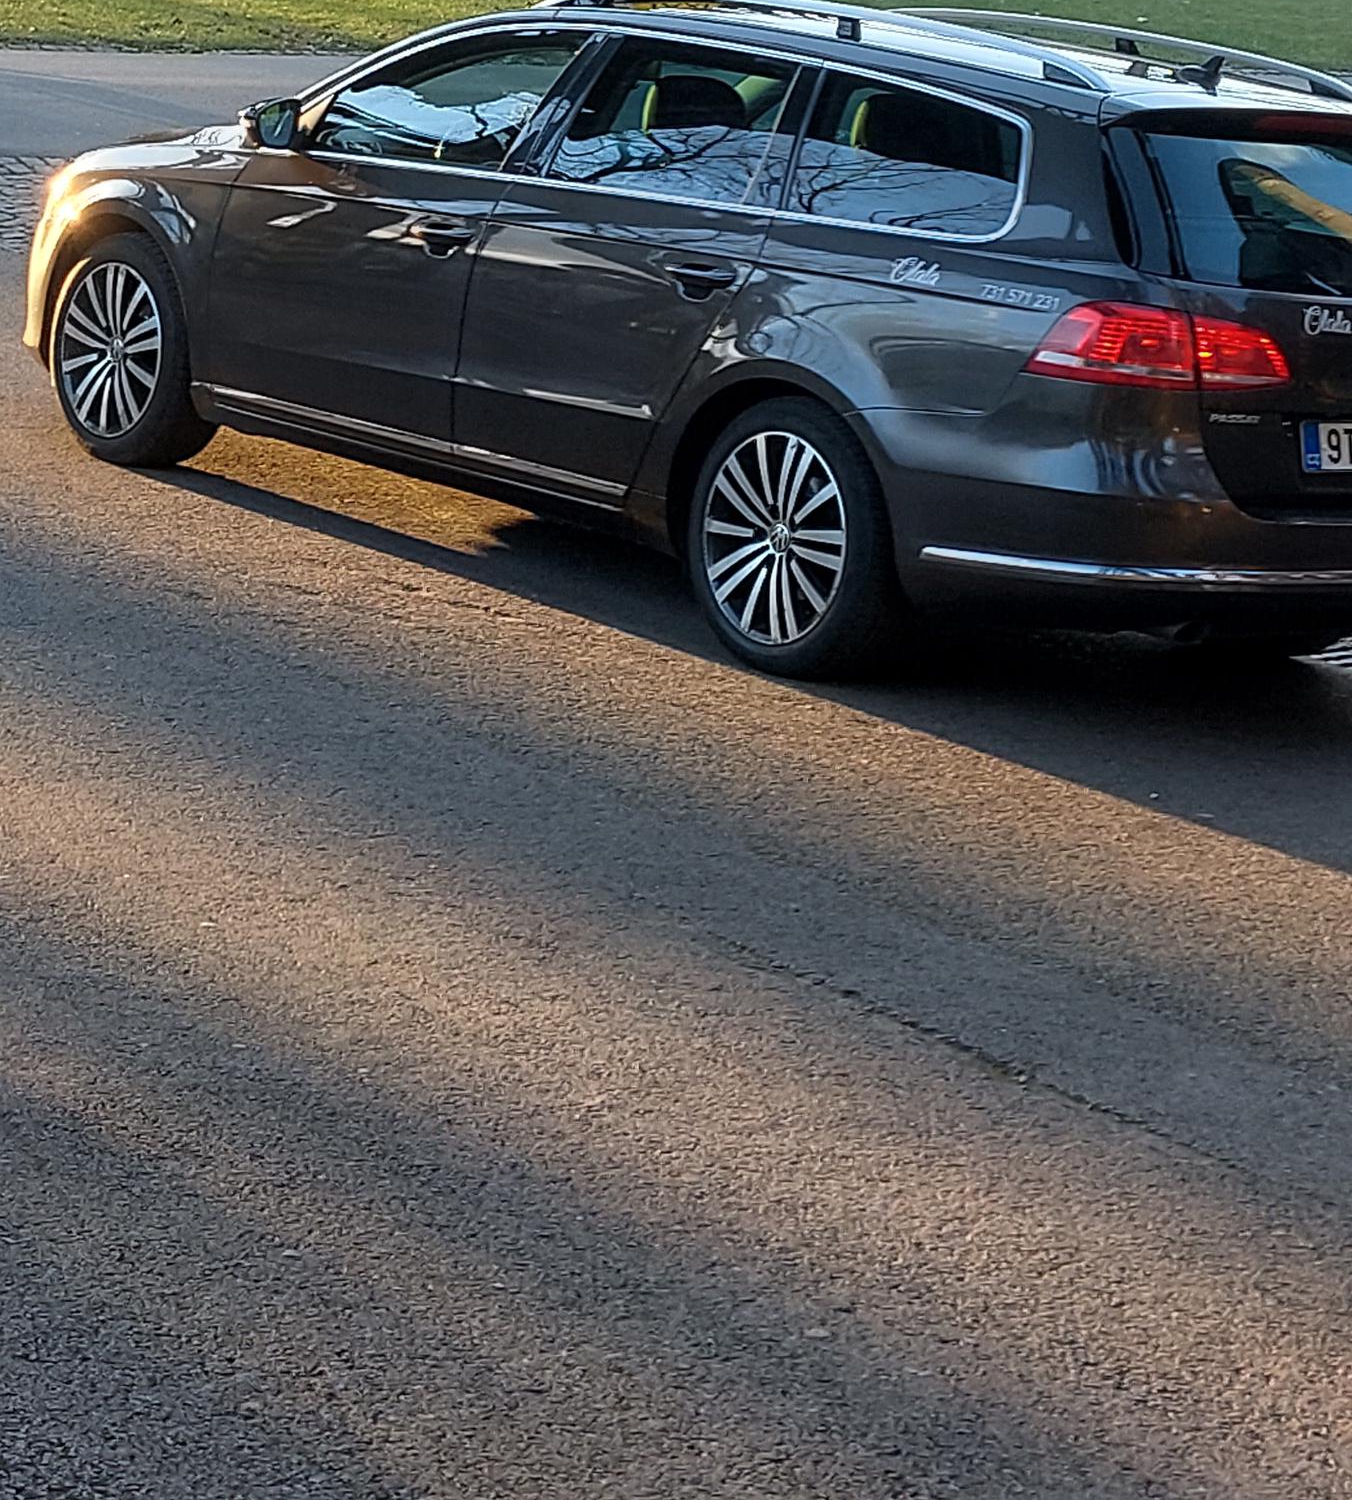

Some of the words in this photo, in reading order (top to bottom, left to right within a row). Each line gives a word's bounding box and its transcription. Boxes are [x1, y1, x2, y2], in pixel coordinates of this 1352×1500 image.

[981, 284, 1006, 300] 731
[1006, 289, 1032, 304] 571
[1033, 294, 1060, 310] 231
